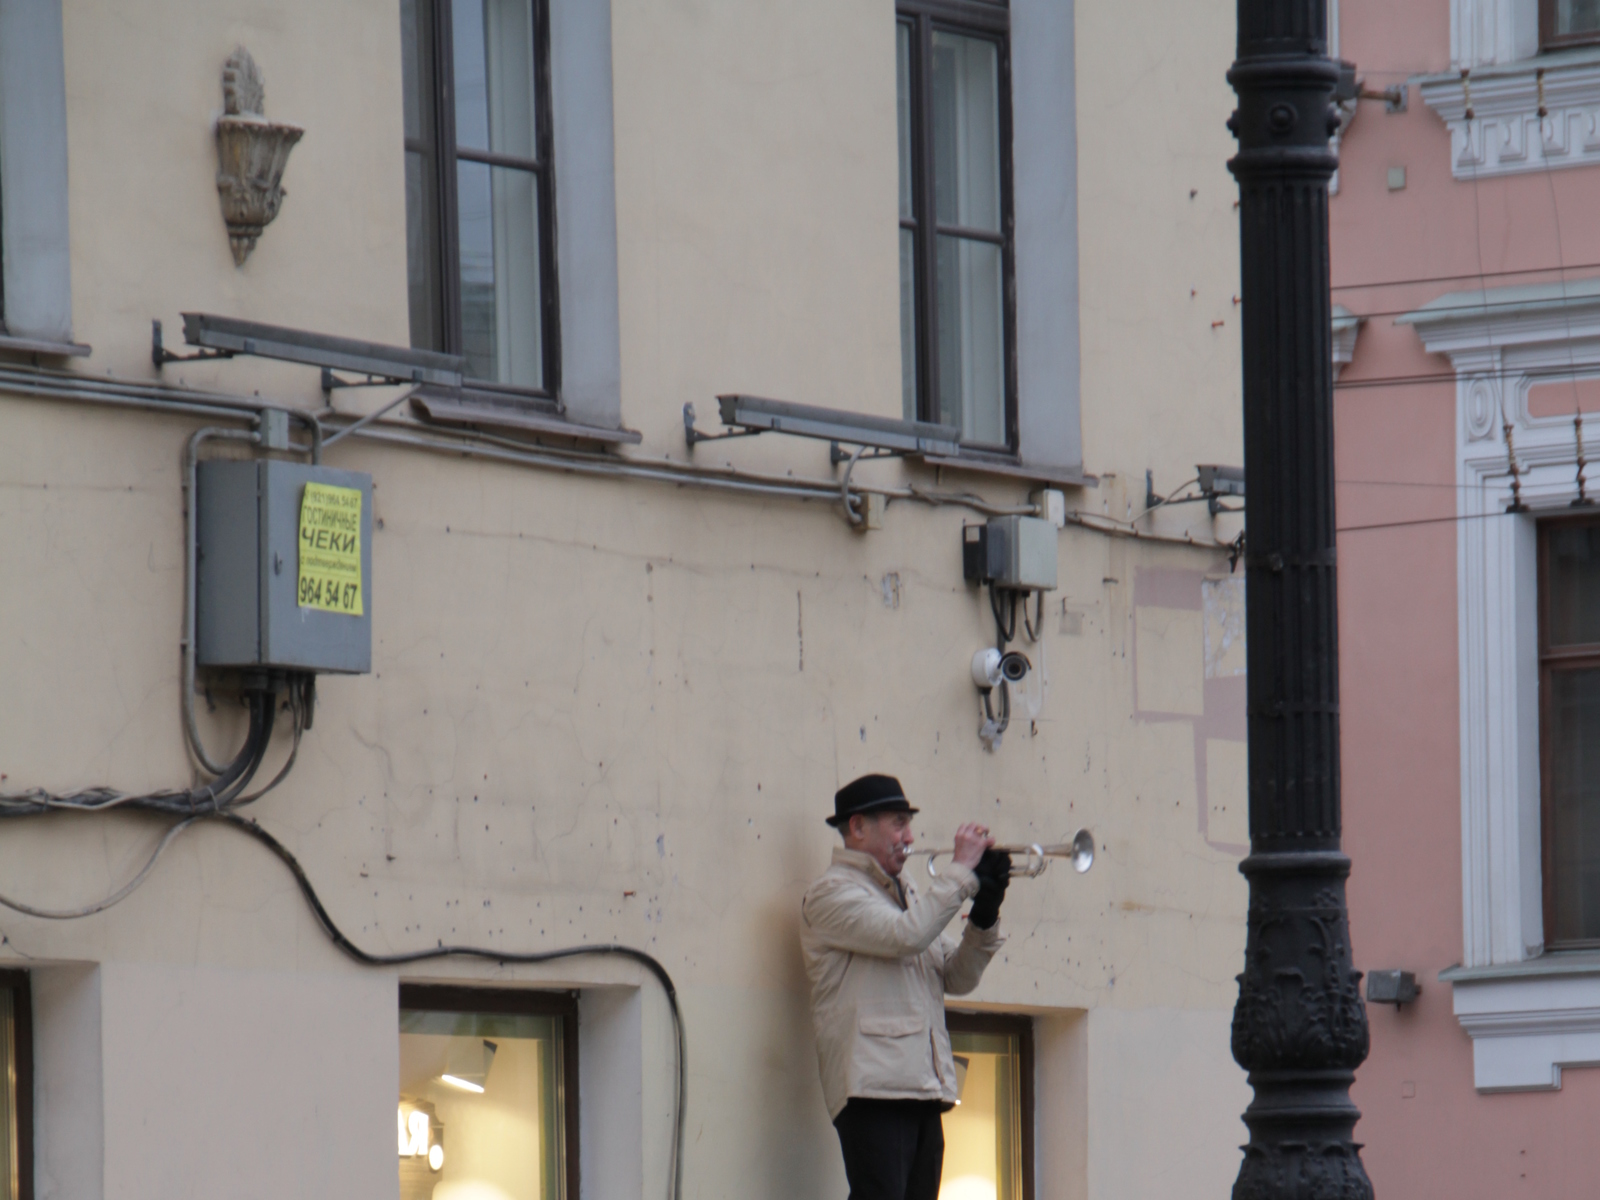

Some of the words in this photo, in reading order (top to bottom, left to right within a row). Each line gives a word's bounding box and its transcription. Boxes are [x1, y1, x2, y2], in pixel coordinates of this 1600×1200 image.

[303, 505, 357, 531] ГОСТИНИЧНЫЕ
[302, 526, 356, 554] ЧЕКИ
[300, 576, 322, 605] 964
[325, 579, 340, 607] 54
[343, 582, 358, 609] 67
